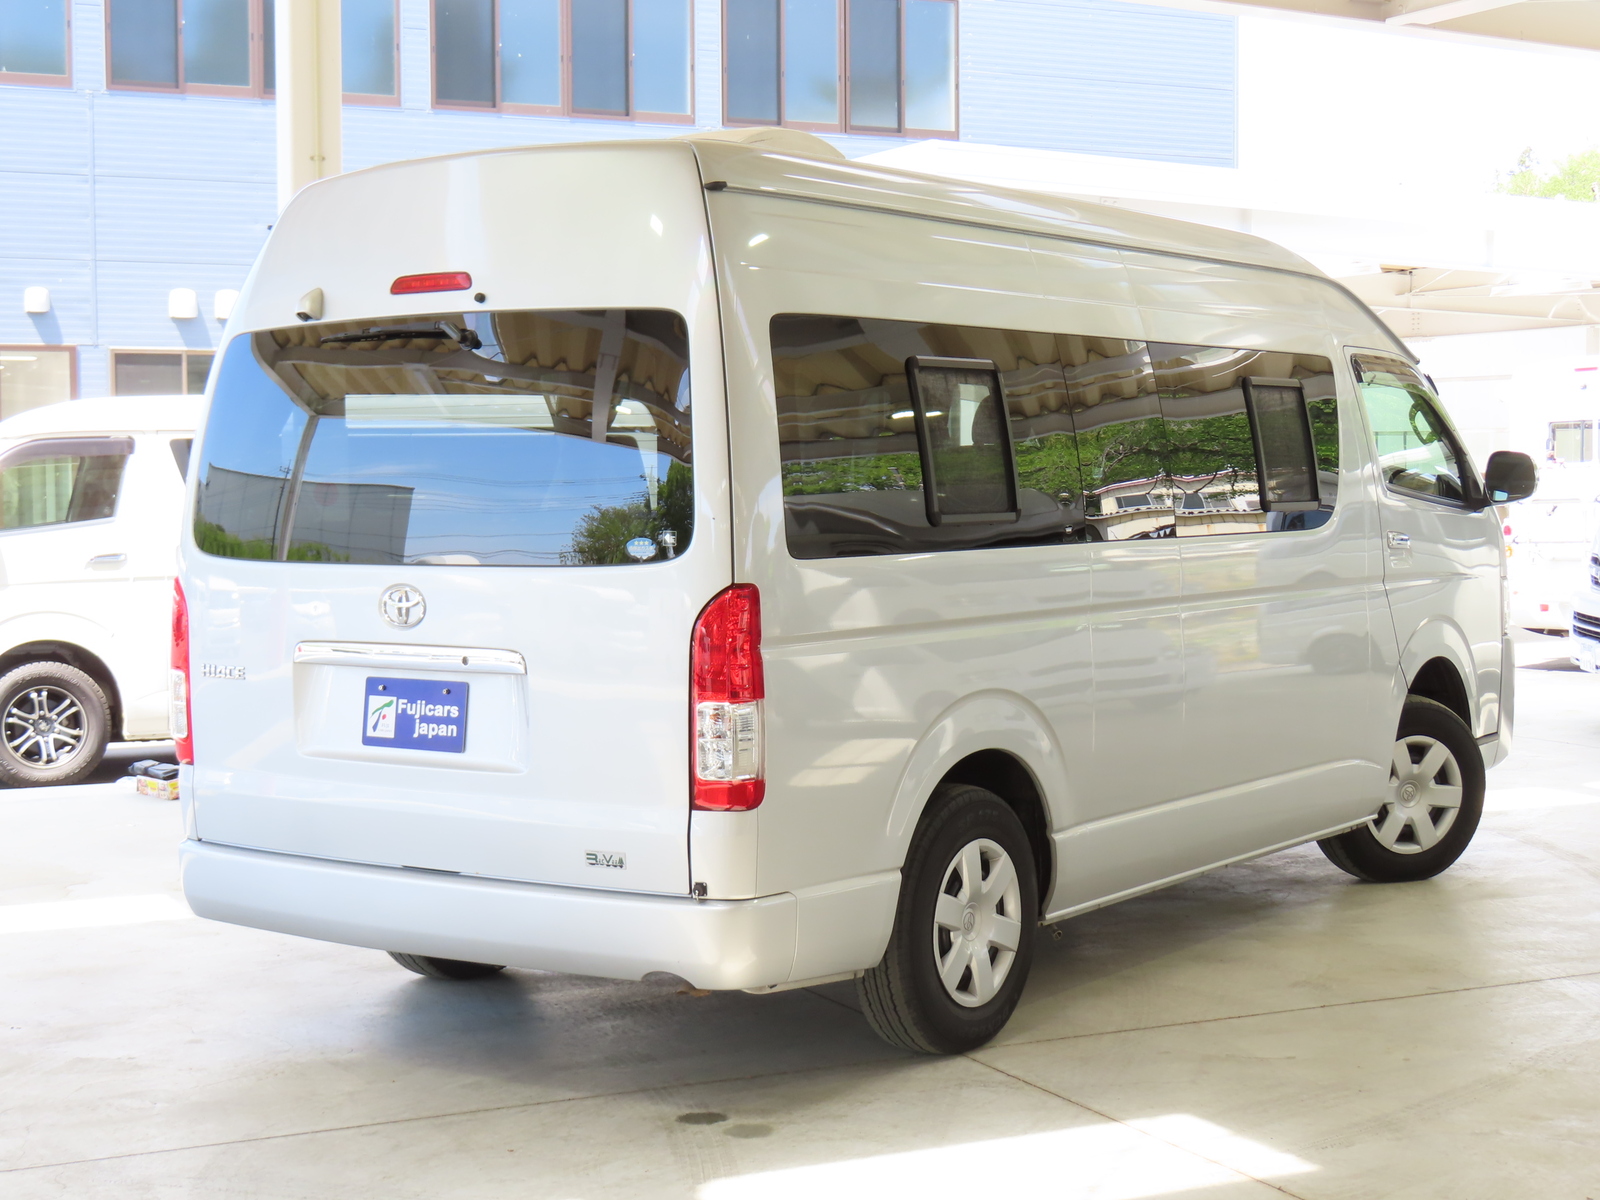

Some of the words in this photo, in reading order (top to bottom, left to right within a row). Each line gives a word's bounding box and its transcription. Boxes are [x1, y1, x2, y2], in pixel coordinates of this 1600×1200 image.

[201, 663, 246, 680] HIACE
[398, 699, 459, 718] Fujicars
[413, 719, 457, 738] japan
